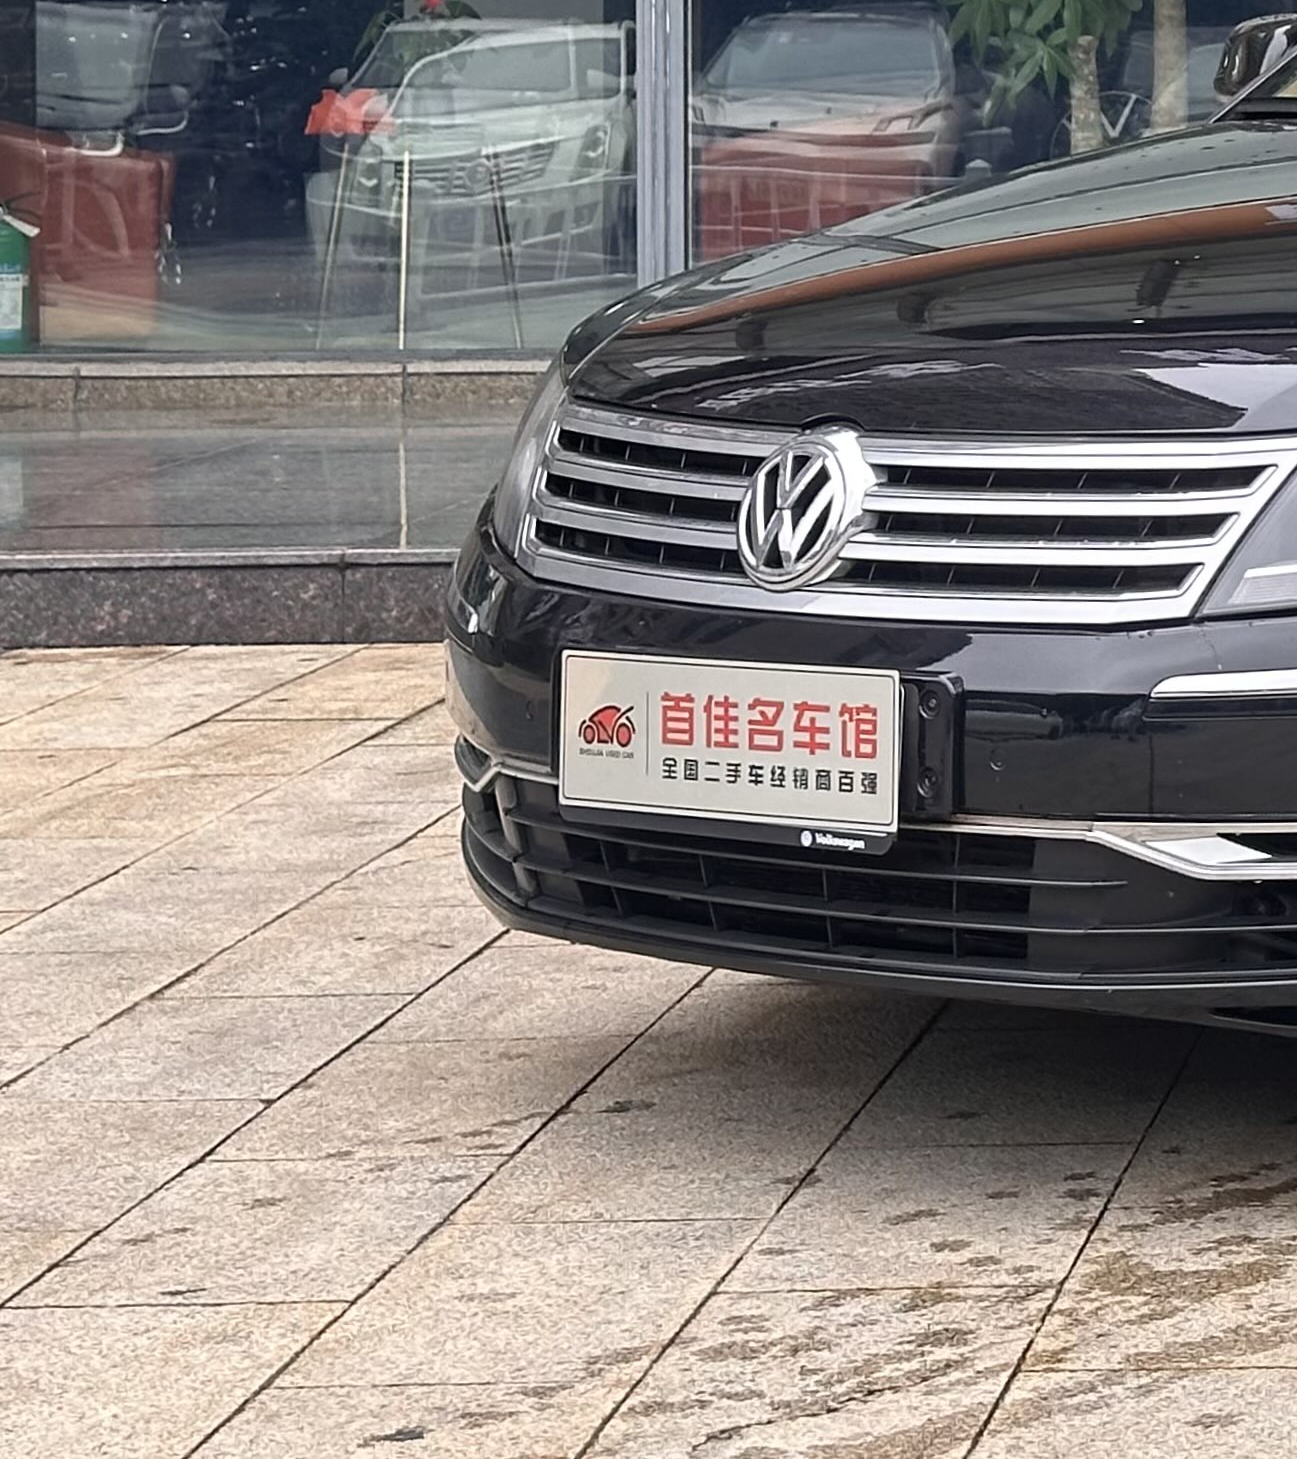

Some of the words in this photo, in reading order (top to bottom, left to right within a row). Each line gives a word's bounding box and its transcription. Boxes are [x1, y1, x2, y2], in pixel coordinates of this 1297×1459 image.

[660, 691, 878, 759] 首佳名车馆
[662, 756, 878, 795] 全国二手车经销商百强
